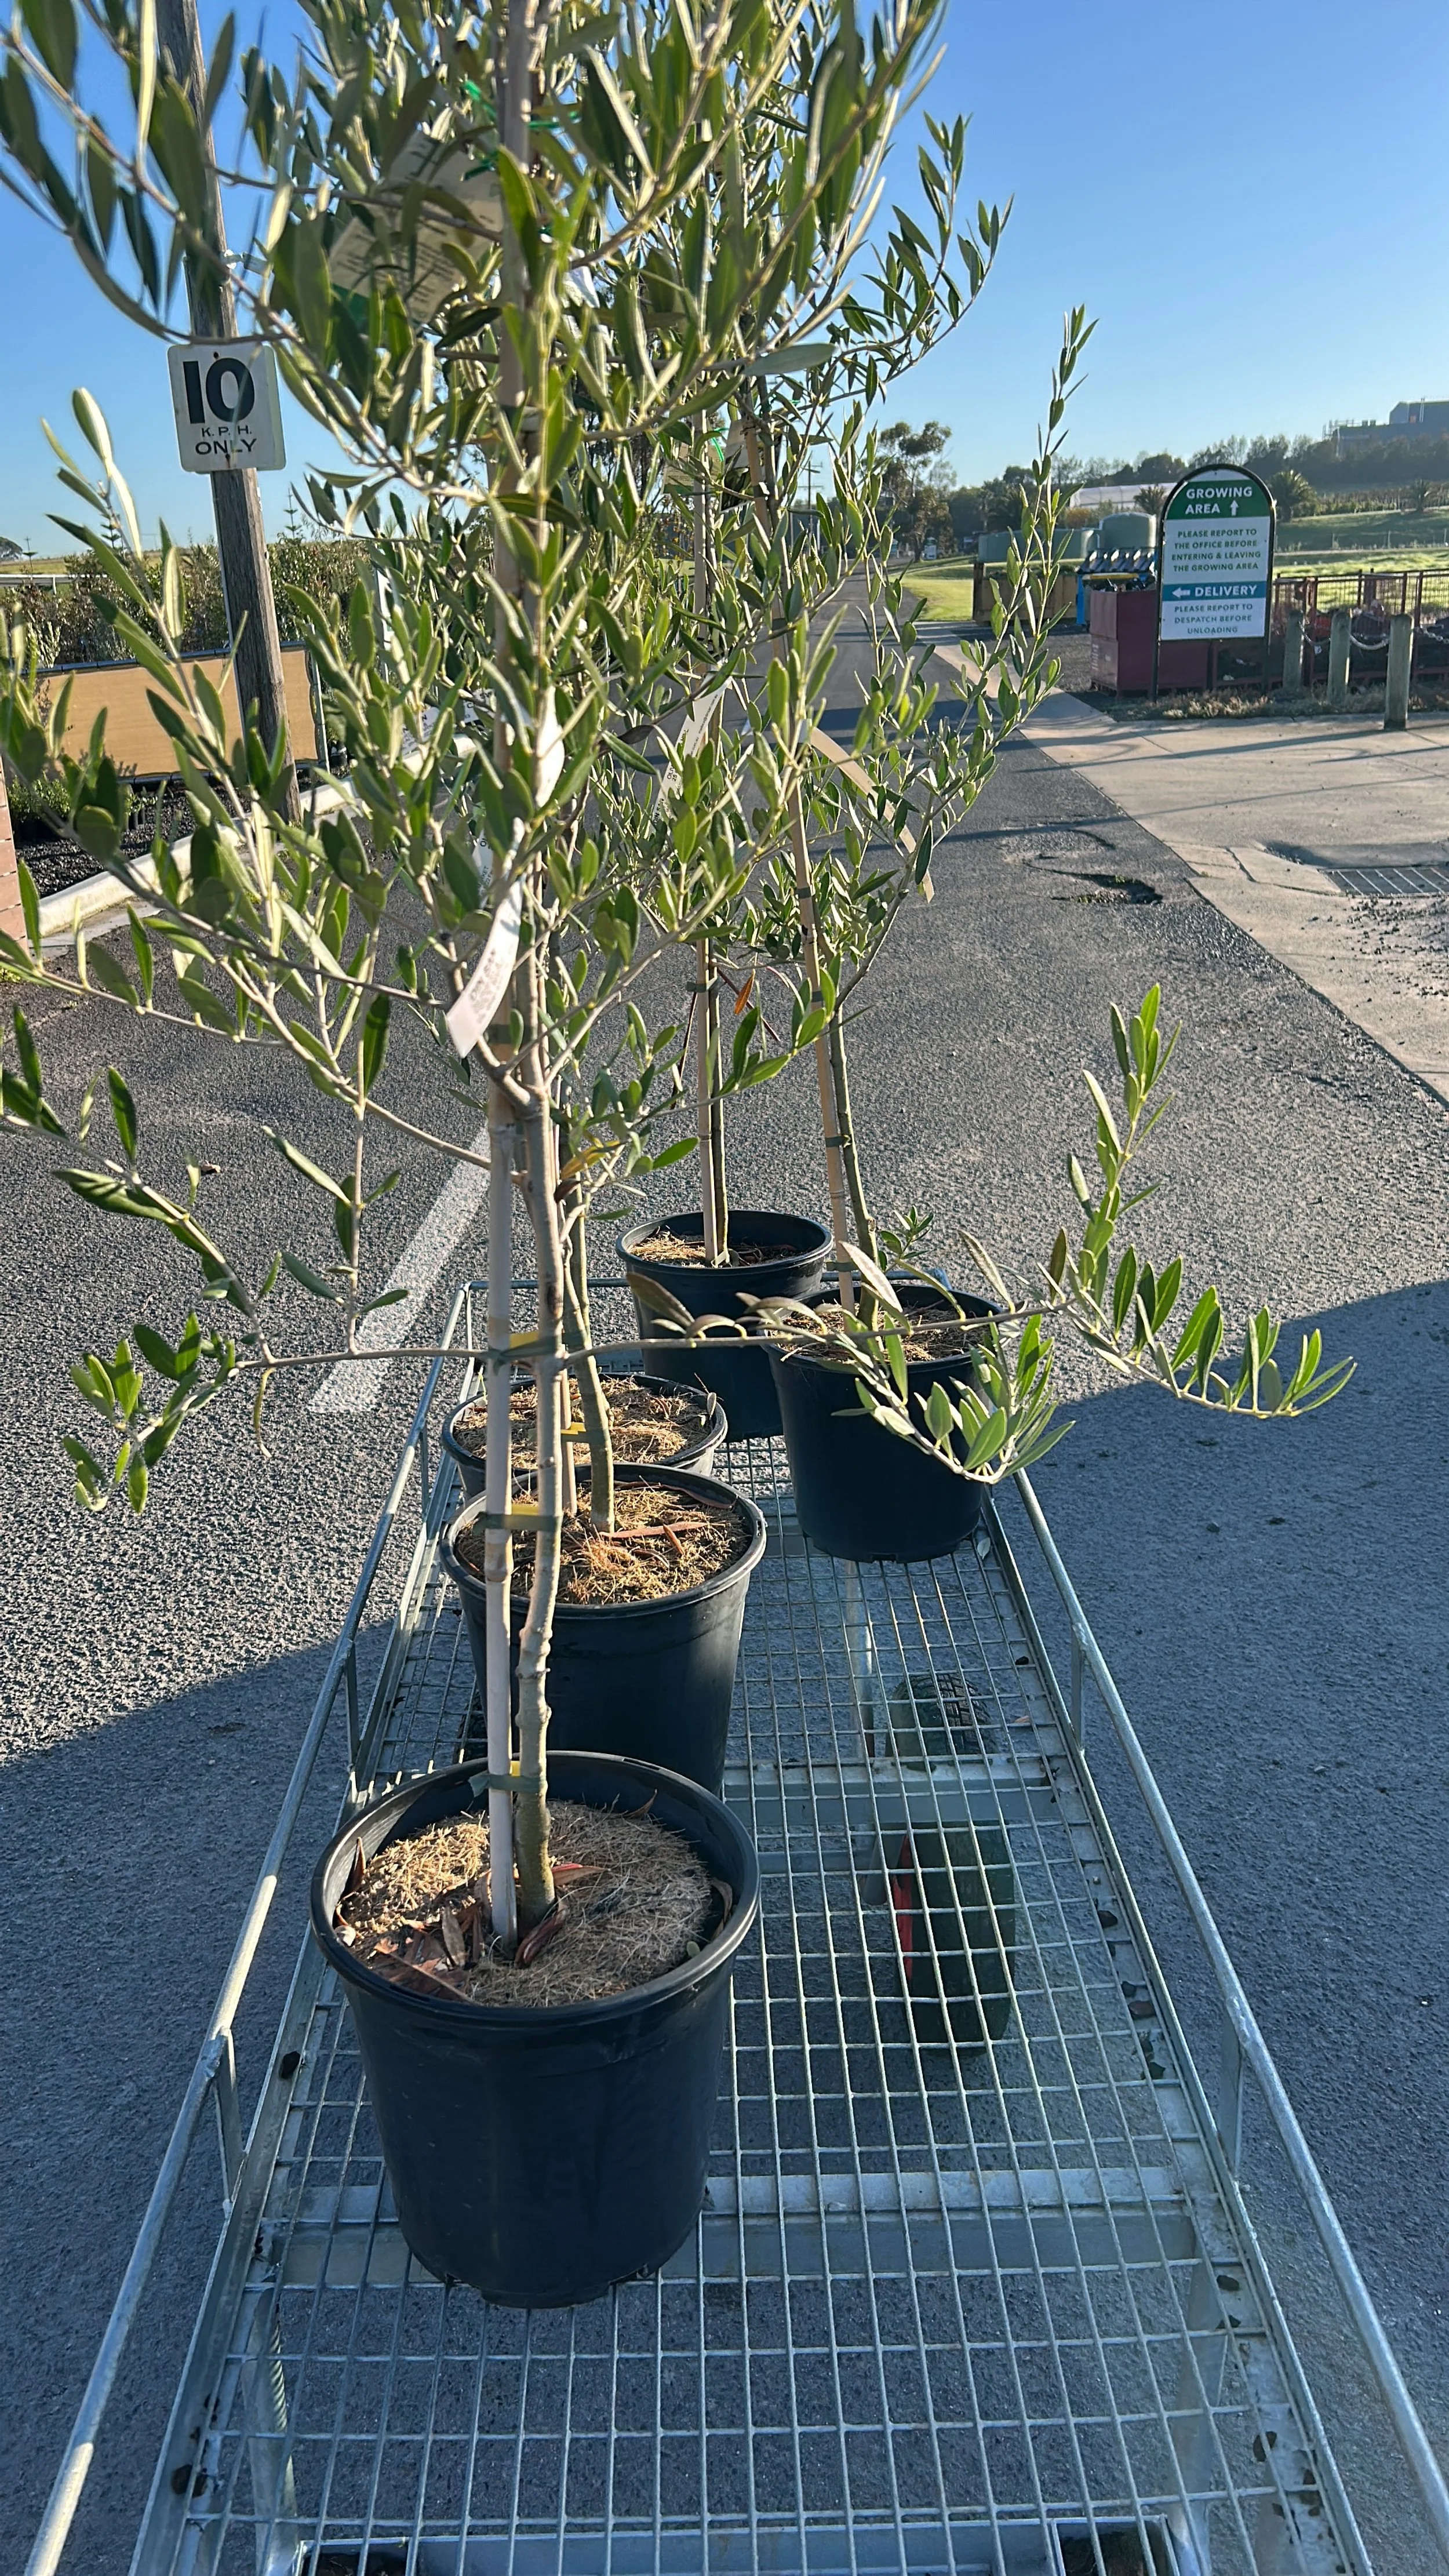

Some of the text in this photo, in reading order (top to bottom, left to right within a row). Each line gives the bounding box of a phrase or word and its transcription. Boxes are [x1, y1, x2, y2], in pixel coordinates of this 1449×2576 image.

[183, 358, 254, 424] 10
[195, 439, 257, 454] ONLY
[1186, 487, 1252, 499] GROWING
[1185, 503, 1220, 514] AREA
[1195, 585, 1257, 596] DELIVERY
